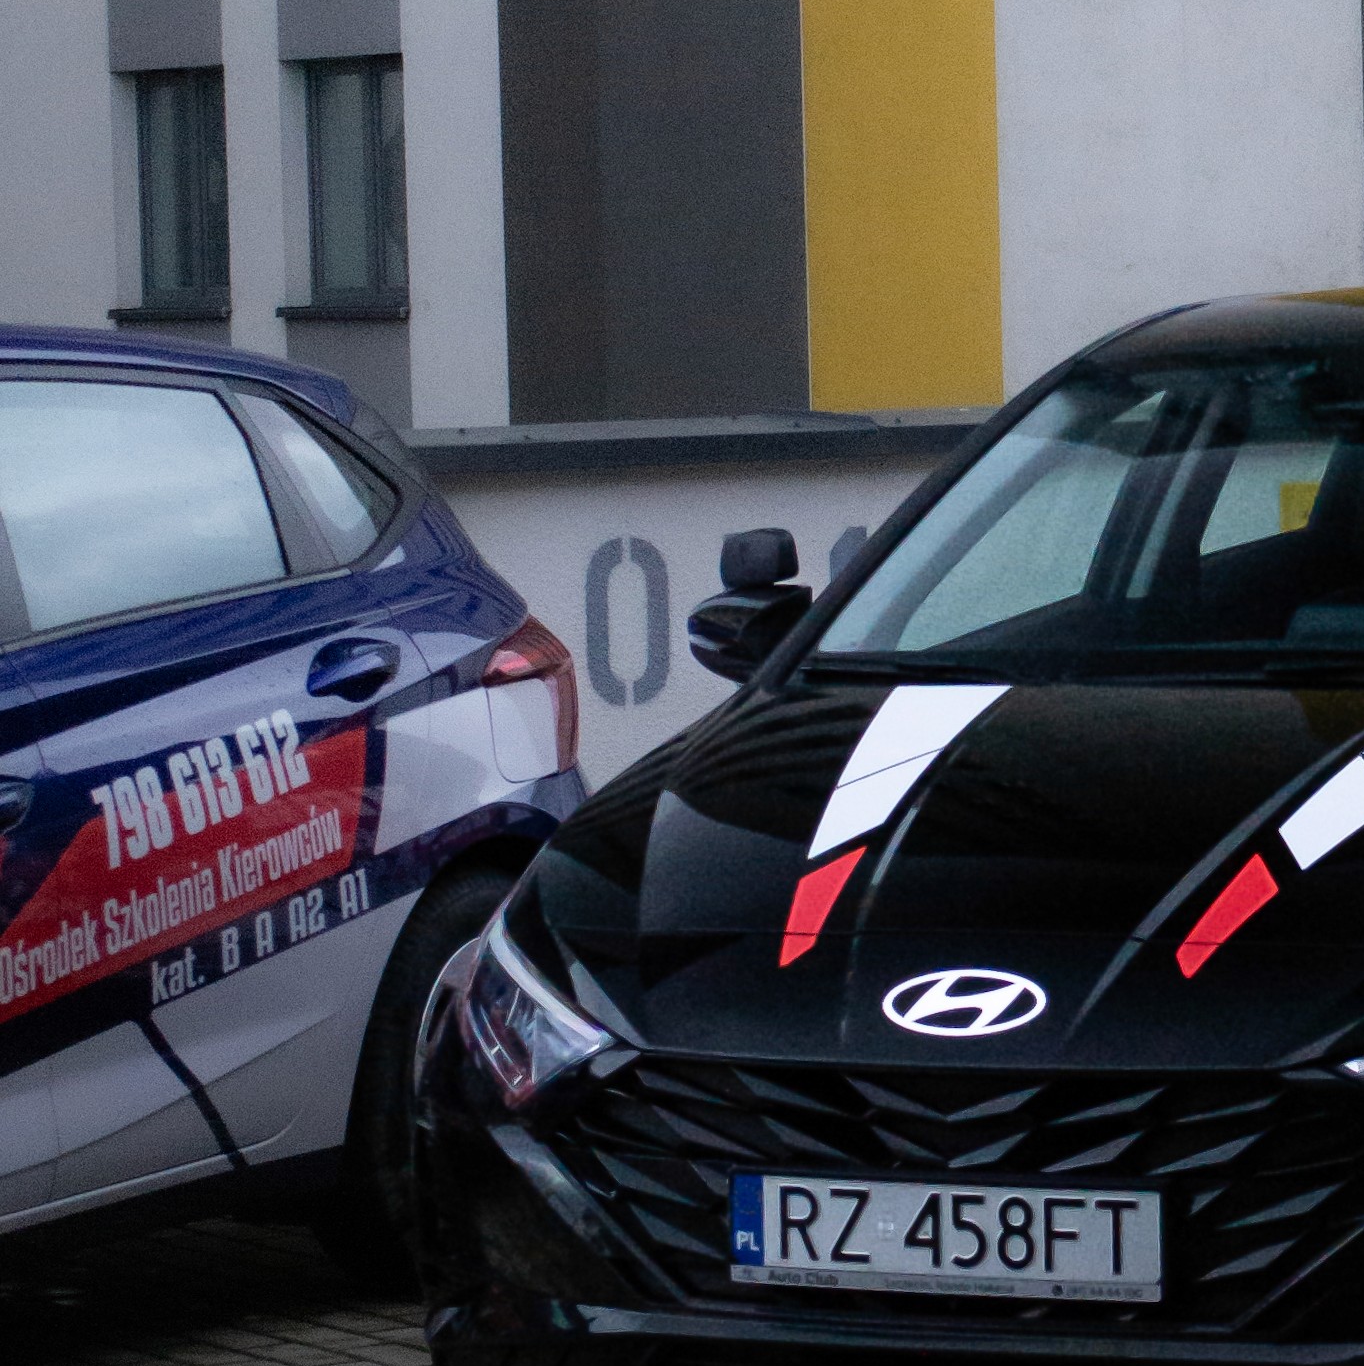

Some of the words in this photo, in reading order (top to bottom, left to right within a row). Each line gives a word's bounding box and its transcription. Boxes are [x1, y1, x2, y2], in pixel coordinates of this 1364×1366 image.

[91, 766, 174, 870] 798
[168, 737, 243, 835] 613
[236, 708, 311, 805] 612
[0, 911, 100, 1004] Ośrodek
[104, 862, 215, 955] Szkolenia
[218, 806, 343, 902] Kierowców
[151, 947, 206, 1004] kat.
[221, 927, 239, 973] B
[256, 912, 274, 957] A
[289, 888, 326, 943] A2
[339, 869, 370, 920] A1
[736, 1230, 760, 1251] PL
[779, 1184, 871, 1263] RZ
[903, 1191, 1139, 1275] 458FT
